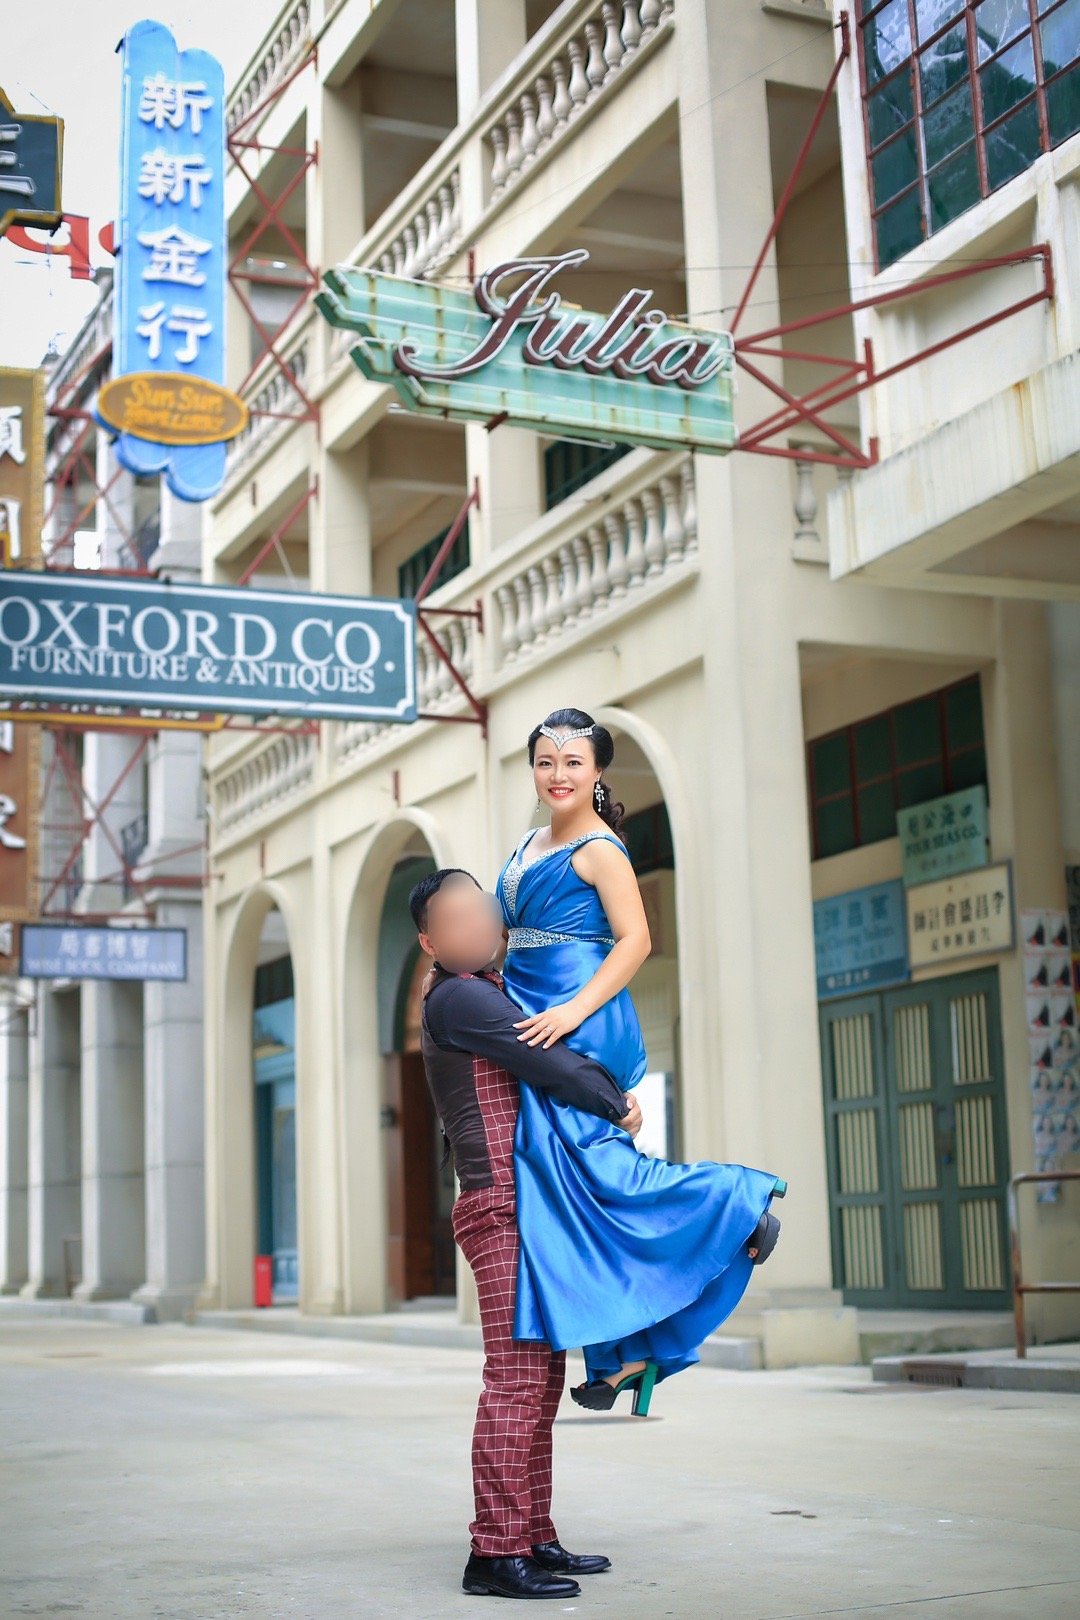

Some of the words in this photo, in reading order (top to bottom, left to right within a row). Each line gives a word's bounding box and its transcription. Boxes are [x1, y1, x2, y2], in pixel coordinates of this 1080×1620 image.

[137, 72, 214, 364] 新新金行
[393, 249, 726, 390] Julia
[0, 596, 277, 662] OXFORD
[11, 646, 189, 682] FURNITURE
[196, 656, 221, 684] &
[225, 661, 375, 696] ANTIQUES
